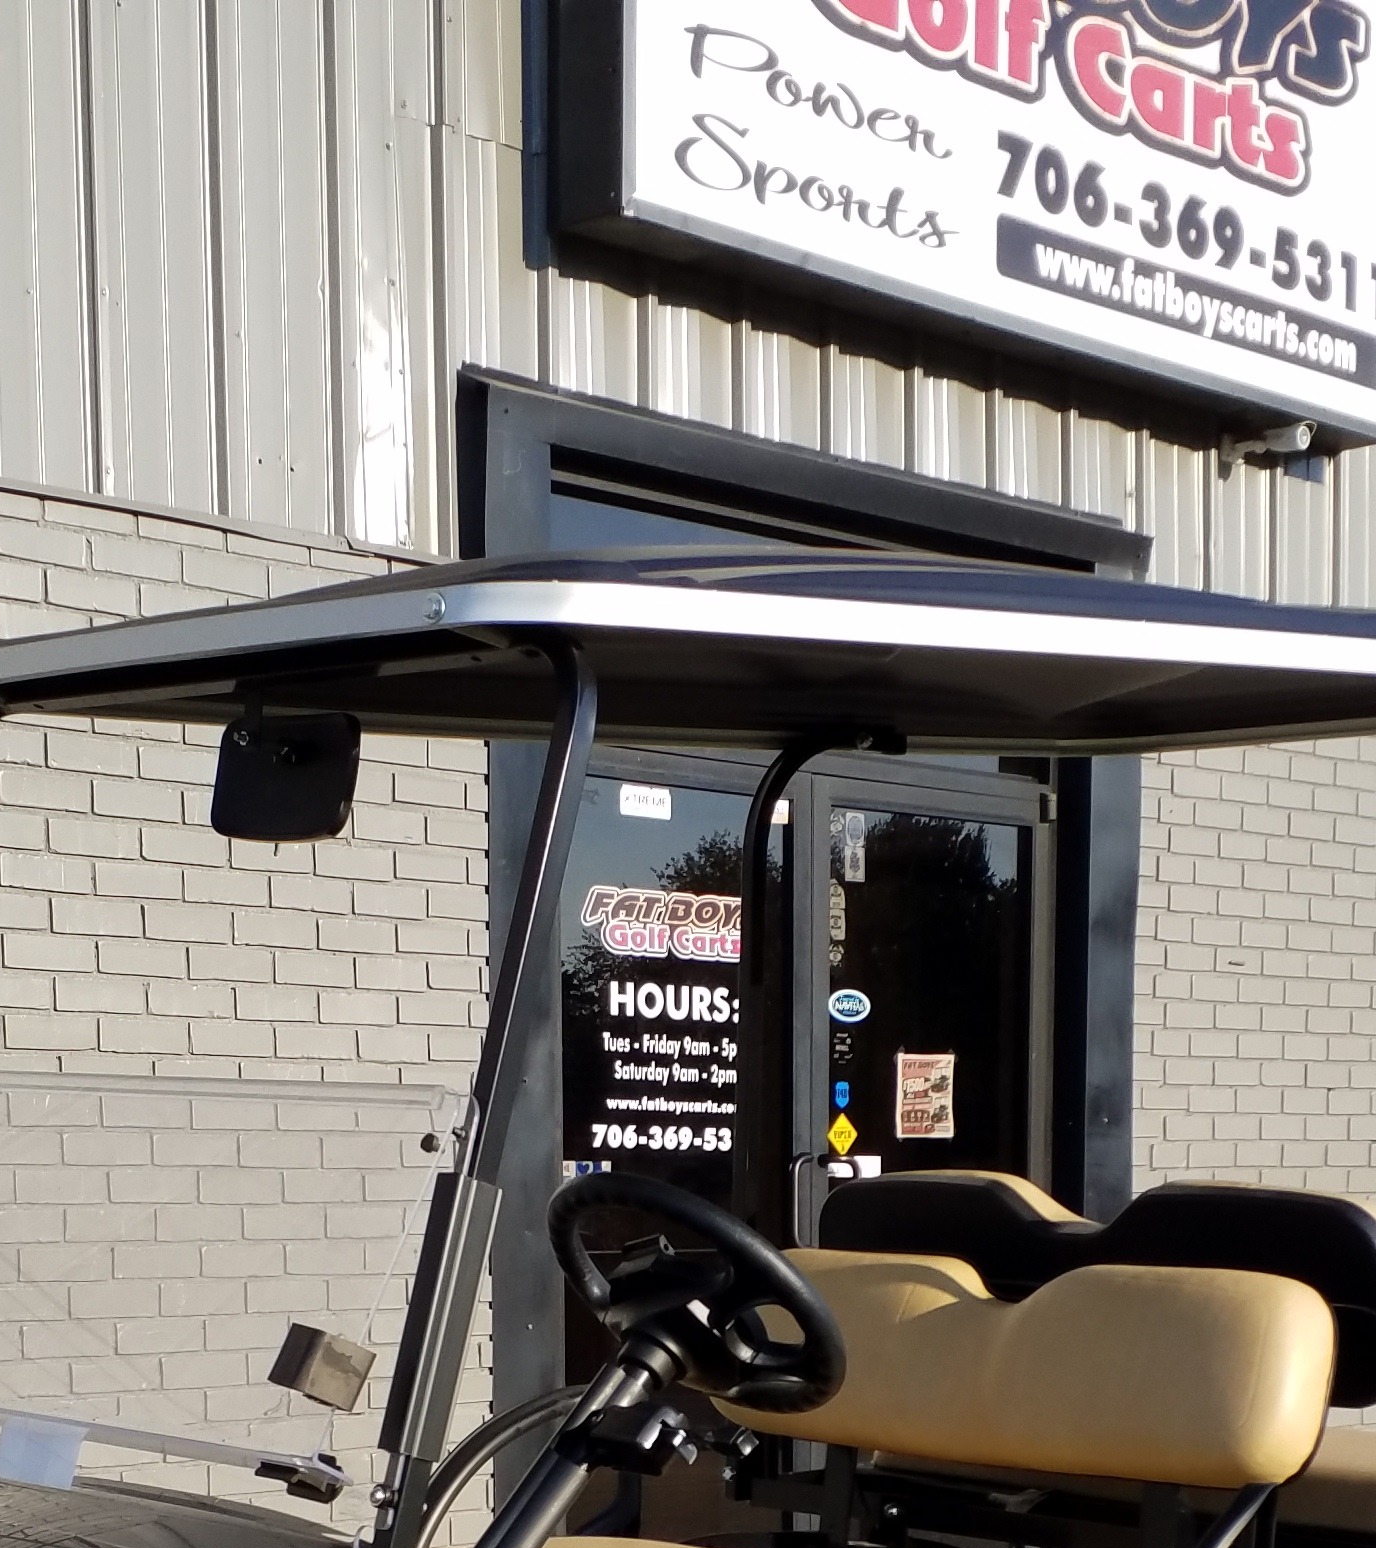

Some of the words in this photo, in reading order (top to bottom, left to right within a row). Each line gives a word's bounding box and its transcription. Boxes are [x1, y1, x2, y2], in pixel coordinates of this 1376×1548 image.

[684, 23, 953, 160] Power
[1070, 20, 1303, 182] Carts
[674, 114, 960, 248] Sports
[1034, 243, 1357, 374] www.fatboyscarts.com
[585, 889, 666, 923] FAT
[666, 895, 741, 930] BOY
[607, 922, 670, 952] Golf
[609, 981, 739, 1024] HOURS:
[603, 1032, 630, 1053] Tues
[643, 1034, 682, 1060] Friday
[684, 1036, 711, 1056] 9am
[614, 1060, 670, 1087] Saturday
[672, 1063, 700, 1082] 9am
[711, 1064, 738, 1088] 2pm
[606, 1096, 737, 1116] www.fatboyscarts.co
[592, 1123, 733, 1151] 706-369-53
